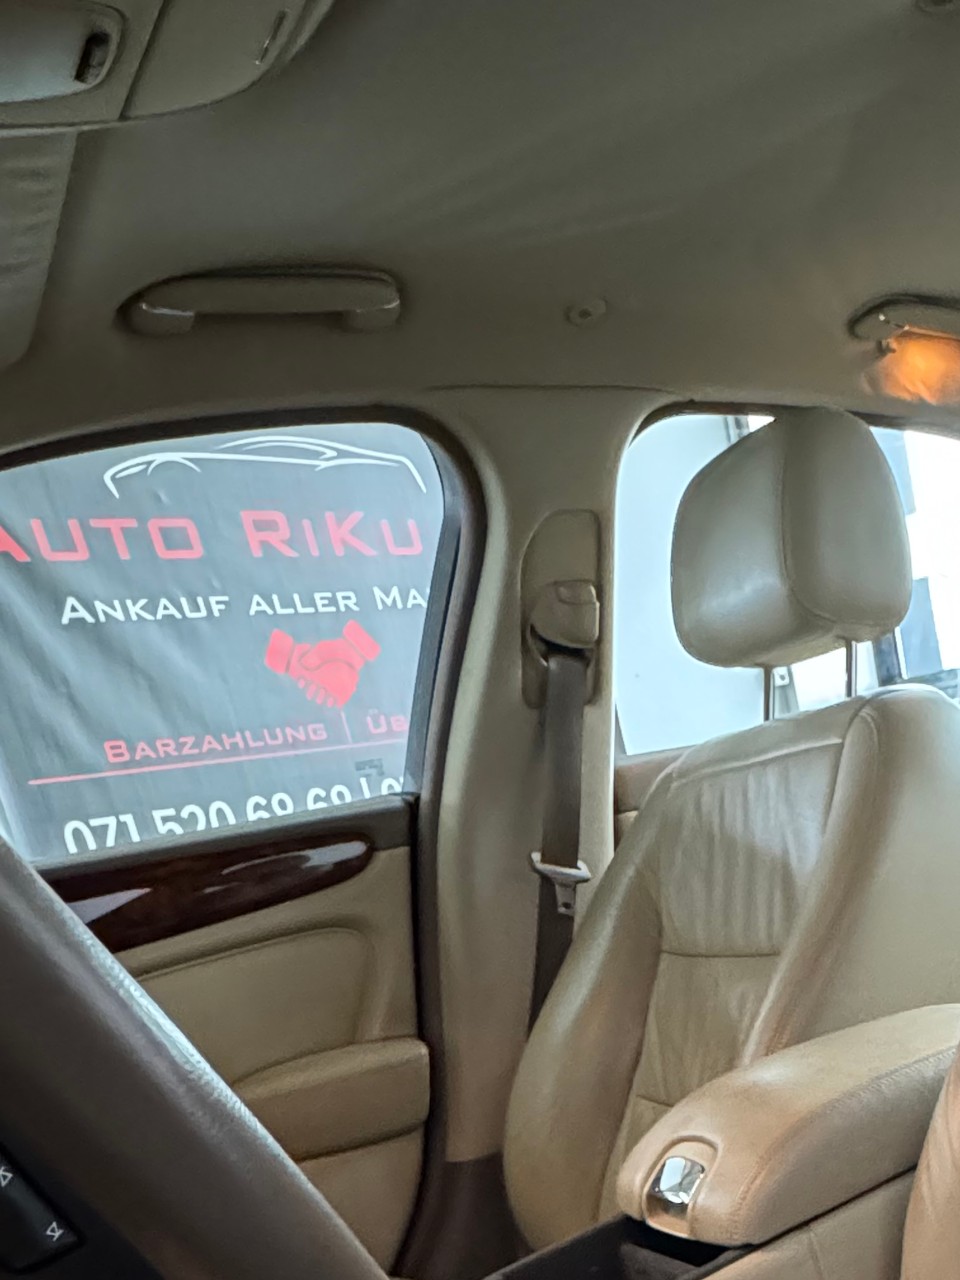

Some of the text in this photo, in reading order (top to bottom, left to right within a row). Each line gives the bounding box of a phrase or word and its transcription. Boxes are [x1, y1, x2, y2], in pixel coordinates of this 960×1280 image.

[61, 585, 430, 624] ANKAUF ALLER MA
[103, 723, 327, 764] BARZAHLUNG
[63, 813, 141, 854] 071
